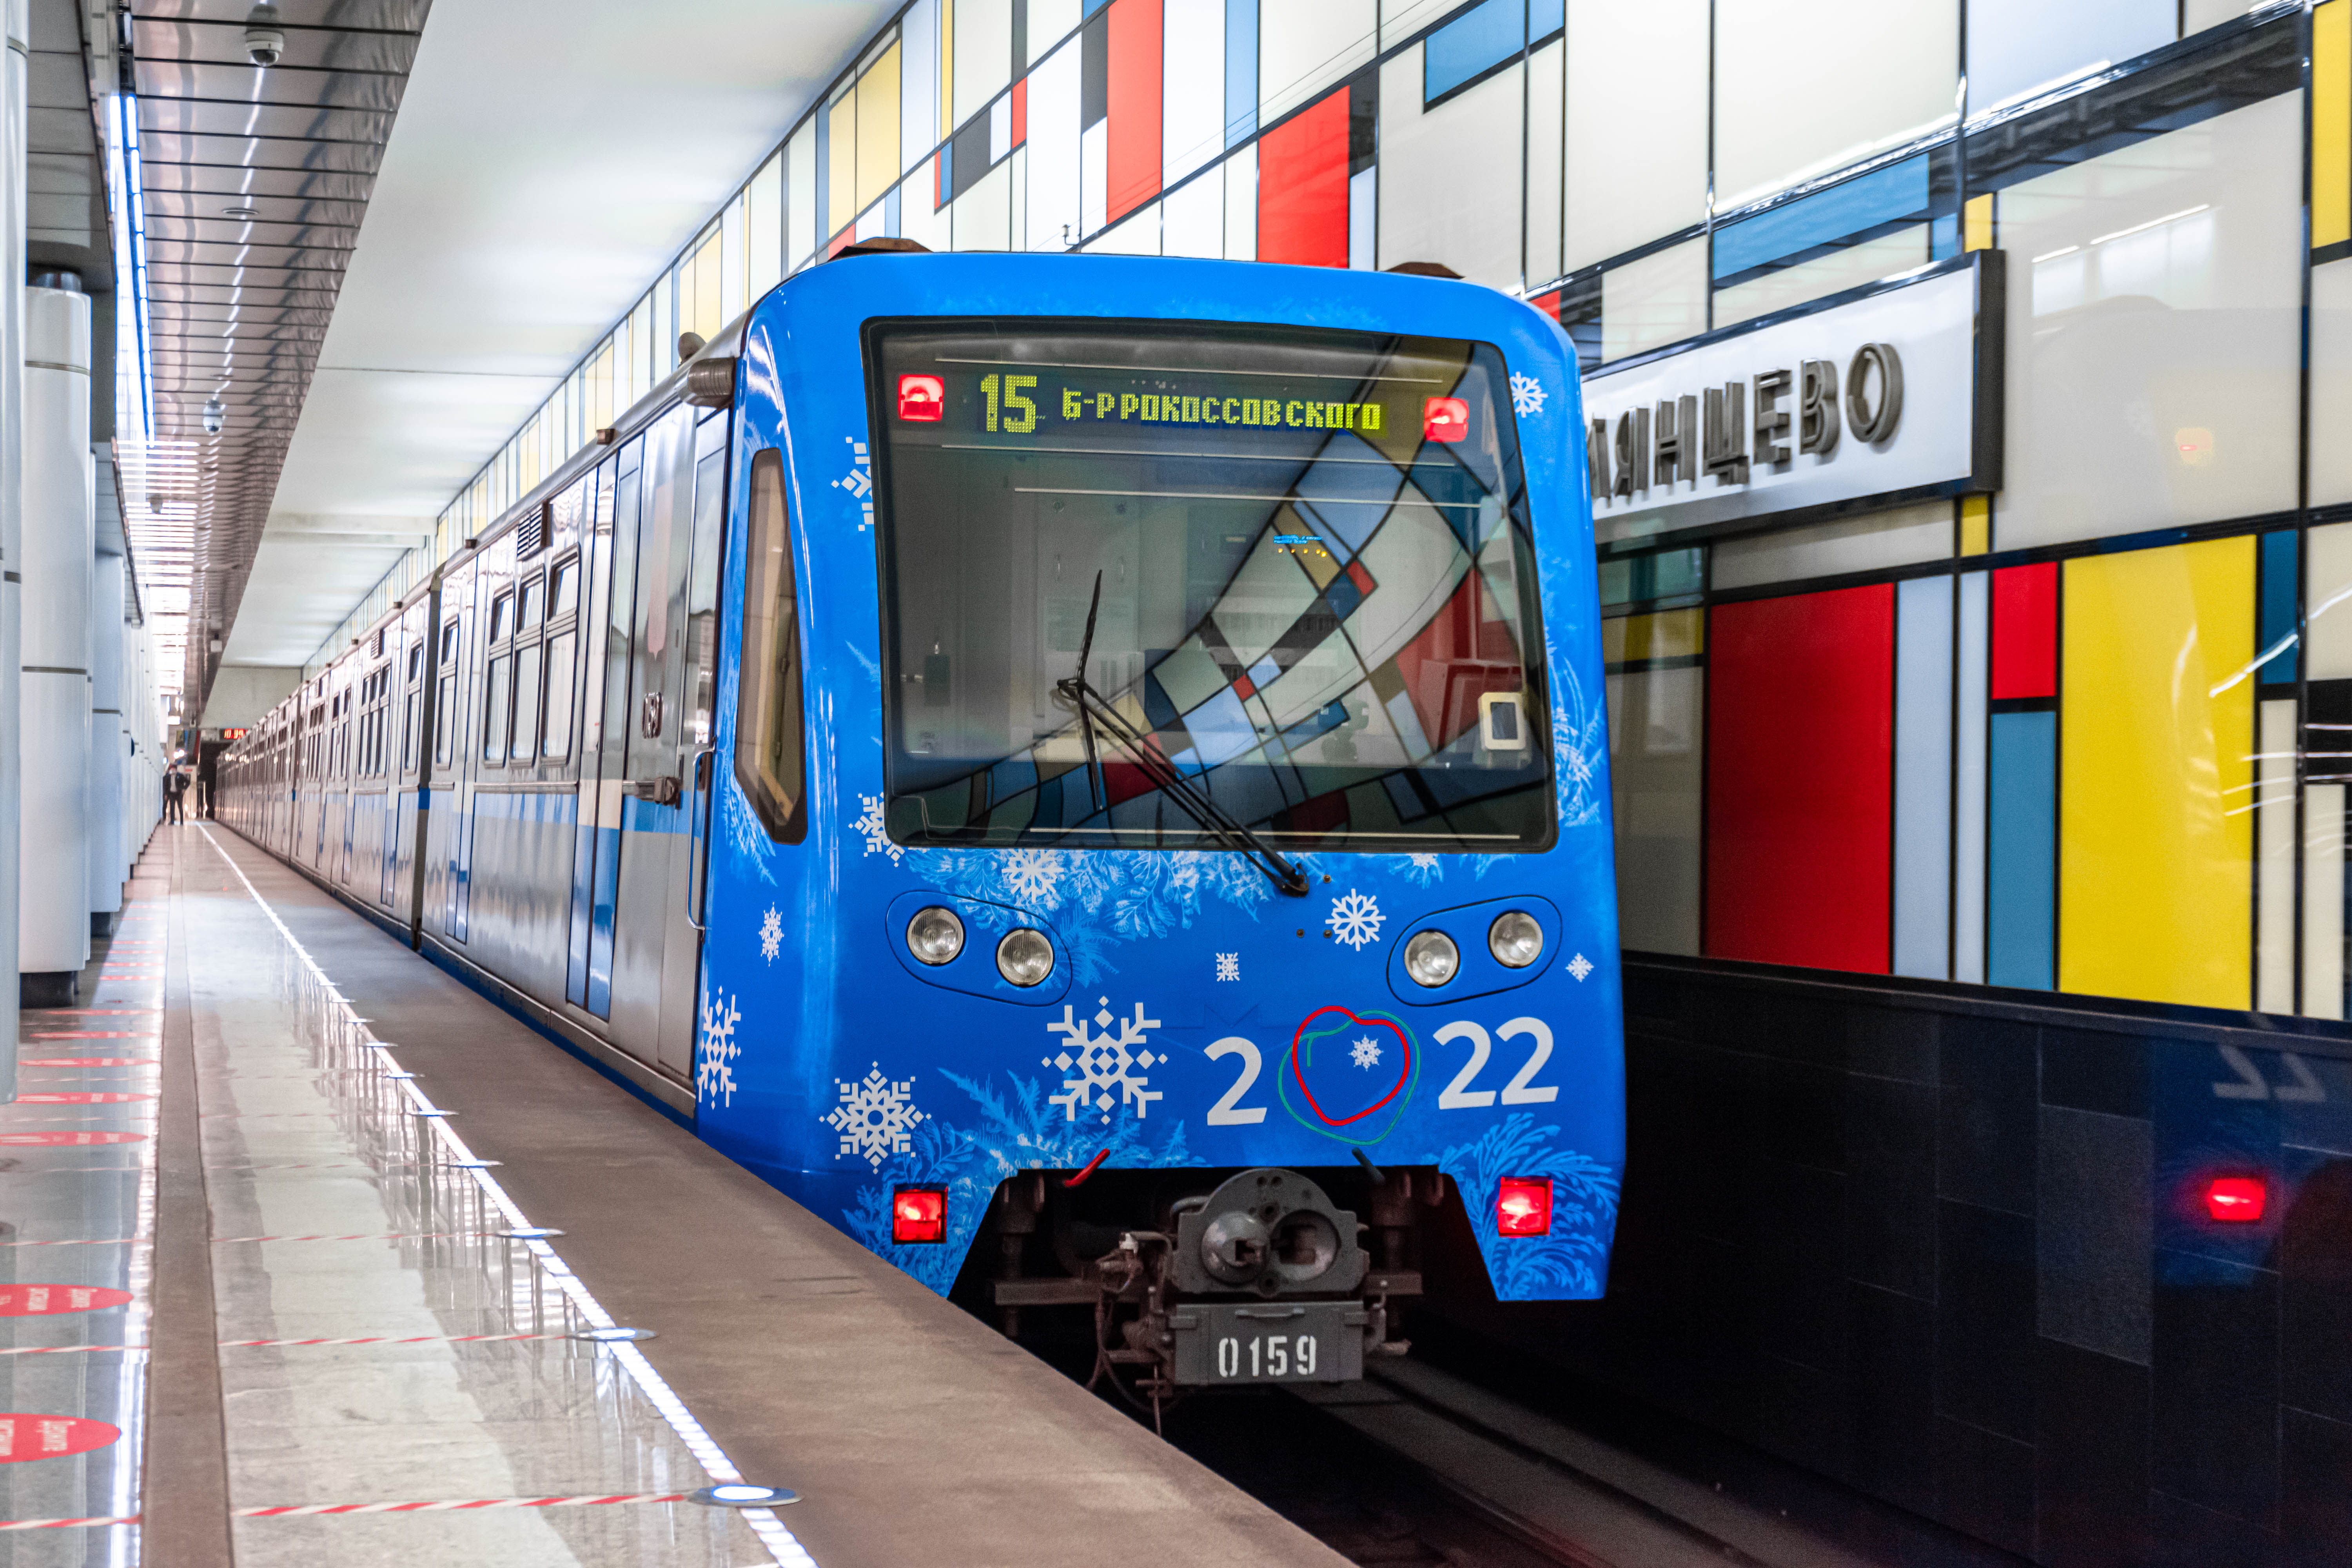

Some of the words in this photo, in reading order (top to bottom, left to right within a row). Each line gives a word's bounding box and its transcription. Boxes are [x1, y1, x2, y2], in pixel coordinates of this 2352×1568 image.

[981, 374, 1037, 433] 15
[1121, 393, 1381, 430] РОКОССОВСКОГО
[1218, 1336, 1316, 1377] 0159
